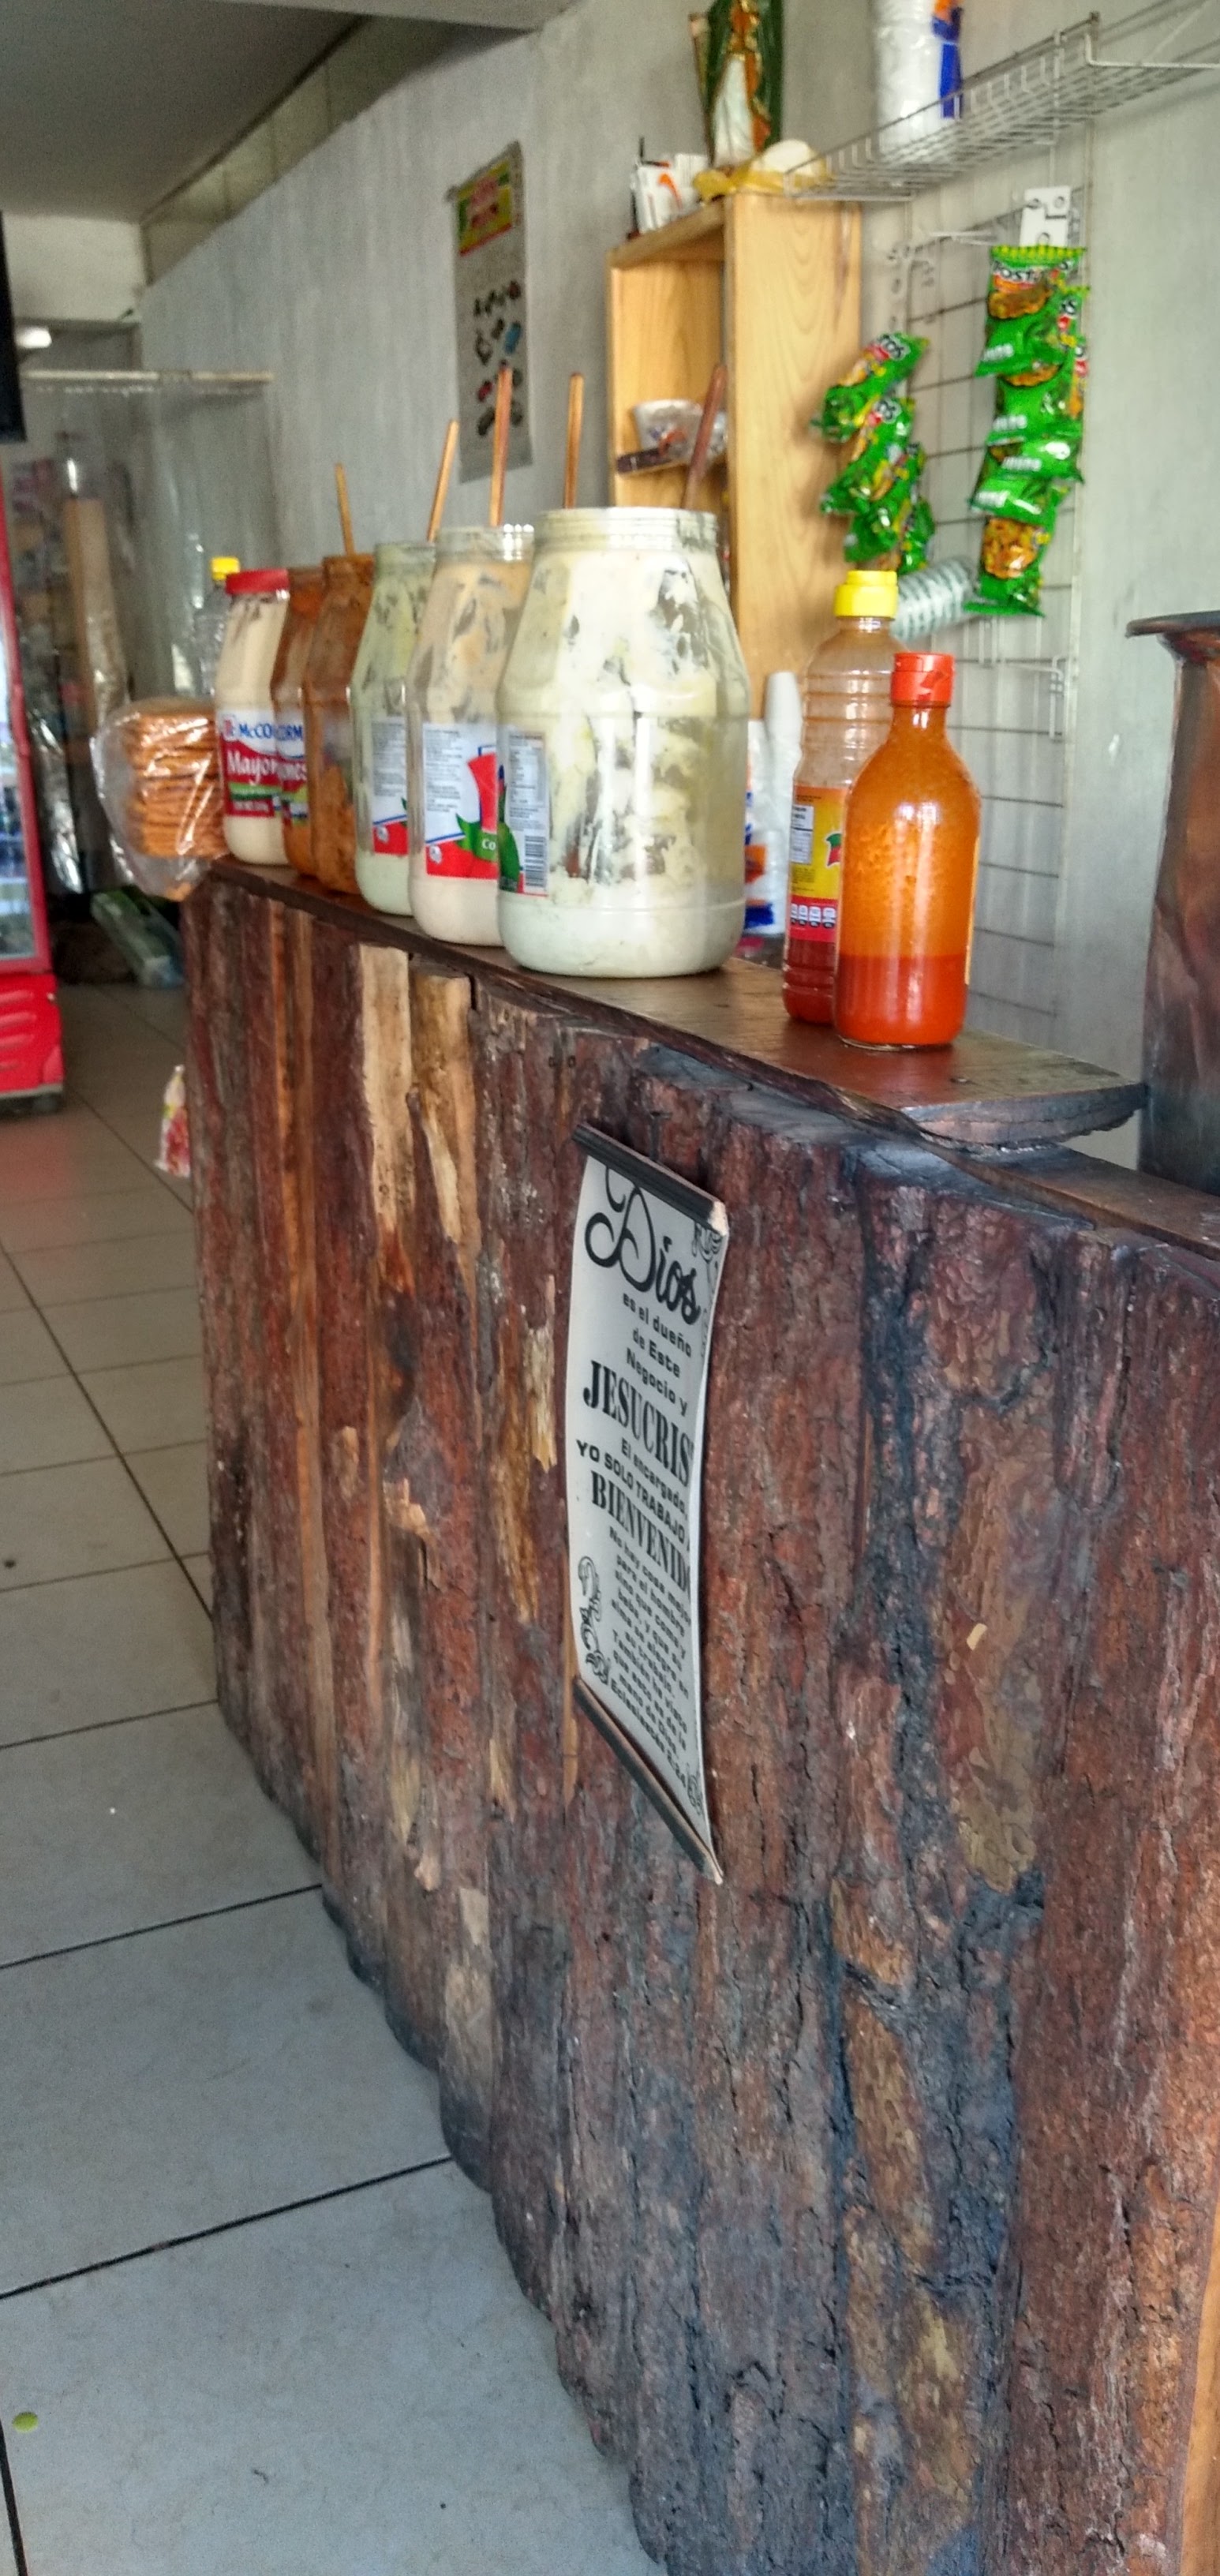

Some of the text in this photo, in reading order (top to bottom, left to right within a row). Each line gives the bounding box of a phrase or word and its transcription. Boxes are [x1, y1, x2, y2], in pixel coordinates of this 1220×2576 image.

[585, 1166, 701, 1324] Dios
[623, 1293, 691, 1357] es el dueño
[633, 1327, 680, 1378] de Este
[627, 1347, 687, 1417] Negocio y
[622, 1438, 631, 1458] El
[576, 1440, 600, 1462] YO
[604, 1453, 633, 1490] SOLO
[636, 1481, 685, 1544] TRABAJO
[609, 1526, 623, 1548] No
[624, 1542, 640, 1569] hay
[642, 1566, 664, 1593] cosa
[616, 1555, 637, 1582] para
[639, 1580, 647, 1594] el
[636, 1593, 652, 1616] que
[655, 1615, 679, 1648] coma
[680, 1645, 686, 1660] y
[645, 1621, 650, 1633] y
[653, 1631, 669, 1654] que
[613, 1650, 629, 1673] que
[667, 1717, 676, 1735] de
[679, 1732, 686, 1750] la
[646, 1705, 656, 1724] de
[653, 1678, 662, 1699] he
[679, 1680, 689, 1699] en
